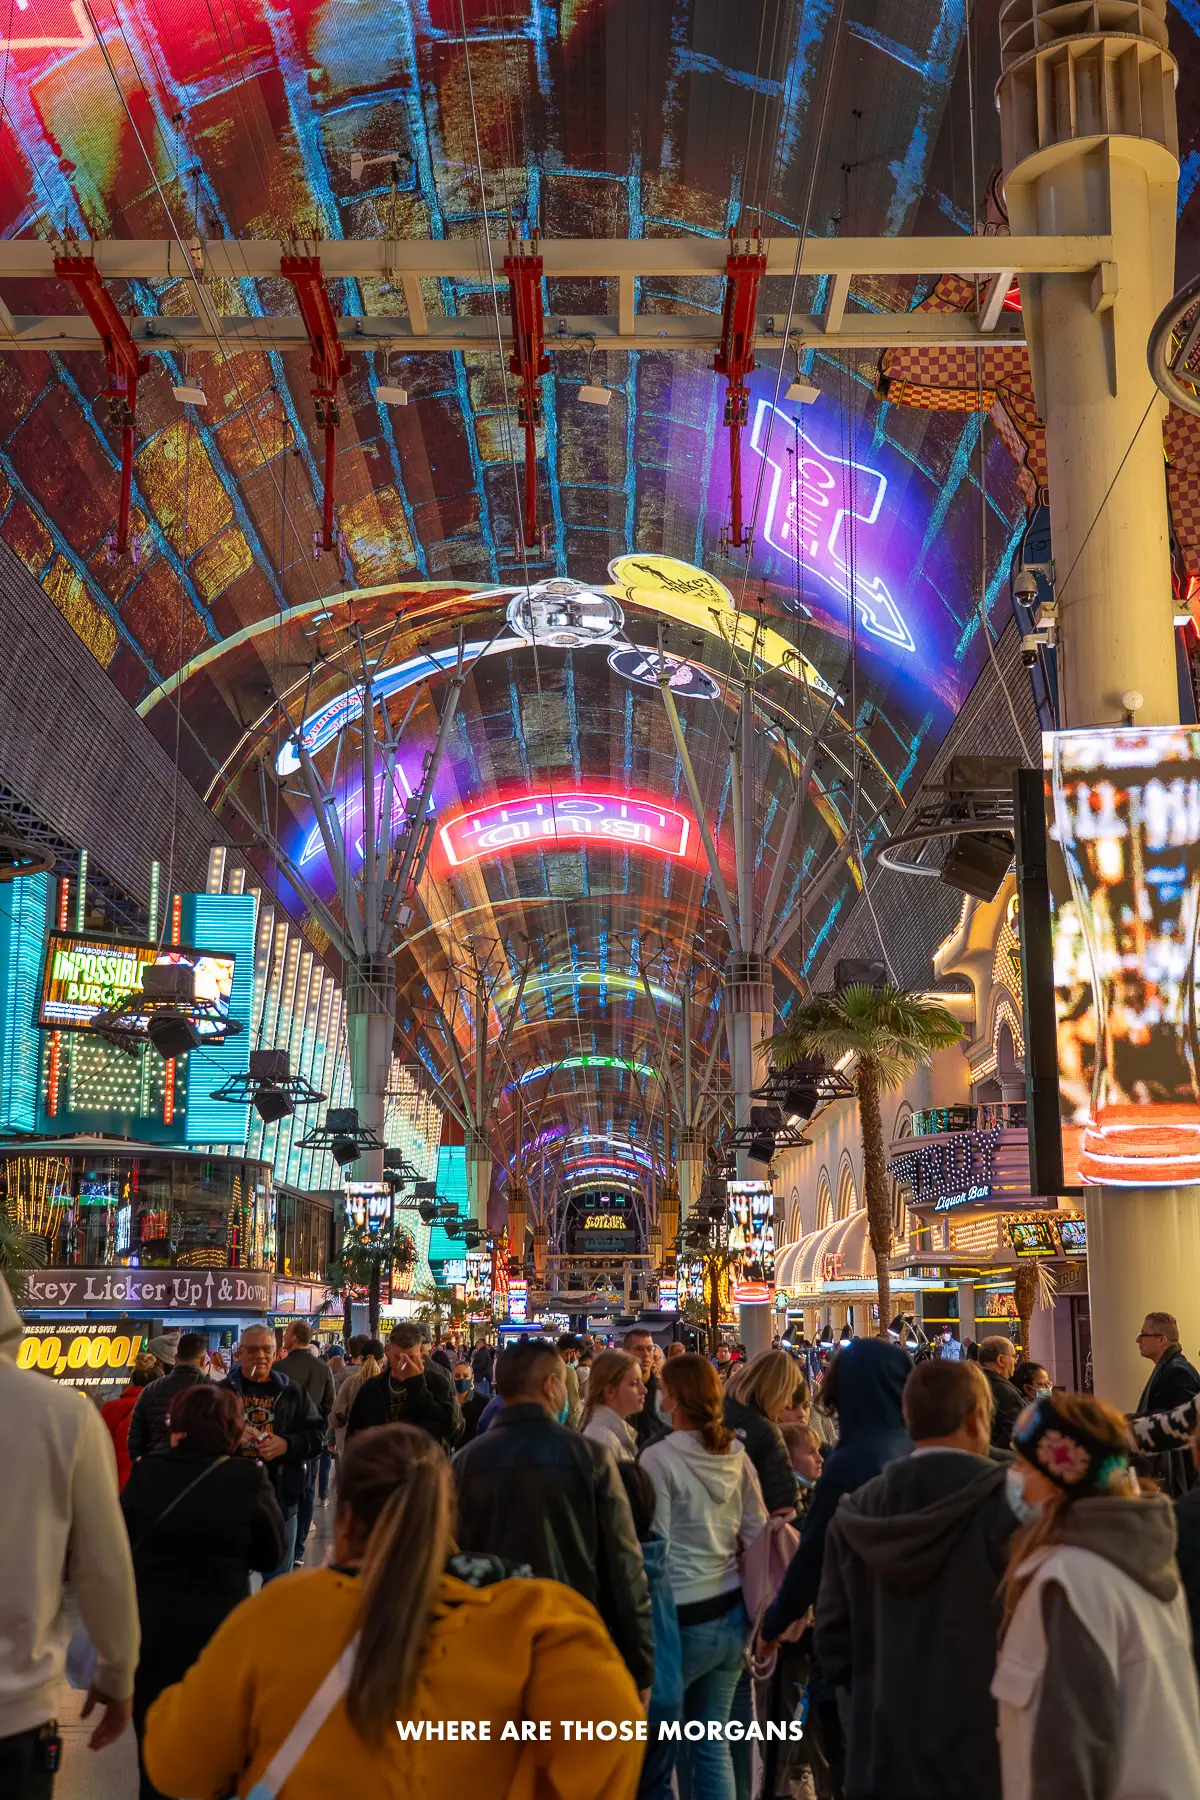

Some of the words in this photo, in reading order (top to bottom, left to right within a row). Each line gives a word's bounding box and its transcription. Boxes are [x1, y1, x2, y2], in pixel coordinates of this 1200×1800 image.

[461, 800, 666, 839] LIGHT
[478, 815, 651, 848] BUD
[75, 946, 122, 958] INTRODUCING
[123, 951, 137, 960] THE
[886, 1122, 1001, 1204] TROY
[934, 1195, 967, 1211] Liquor
[967, 1184, 989, 1201] Bar
[26, 1274, 77, 1306] key
[83, 1275, 166, 1301] Licker
[173, 1277, 202, 1307] Up
[218, 1277, 233, 1301] &
[236, 1279, 268, 1301] Down
[1057, 1269, 1081, 1288] TROY
[56, 1325, 88, 1334] JACKPOT
[88, 1325, 97, 1334] IS
[98, 1325, 117, 1334] OVER
[16, 1335, 143, 1376] 00,000!
[58, 1378, 75, 1386] GATE
[75, 1378, 84, 1386] TO
[84, 1377, 101, 1386] PLAY
[100, 1377, 115, 1385] AND
